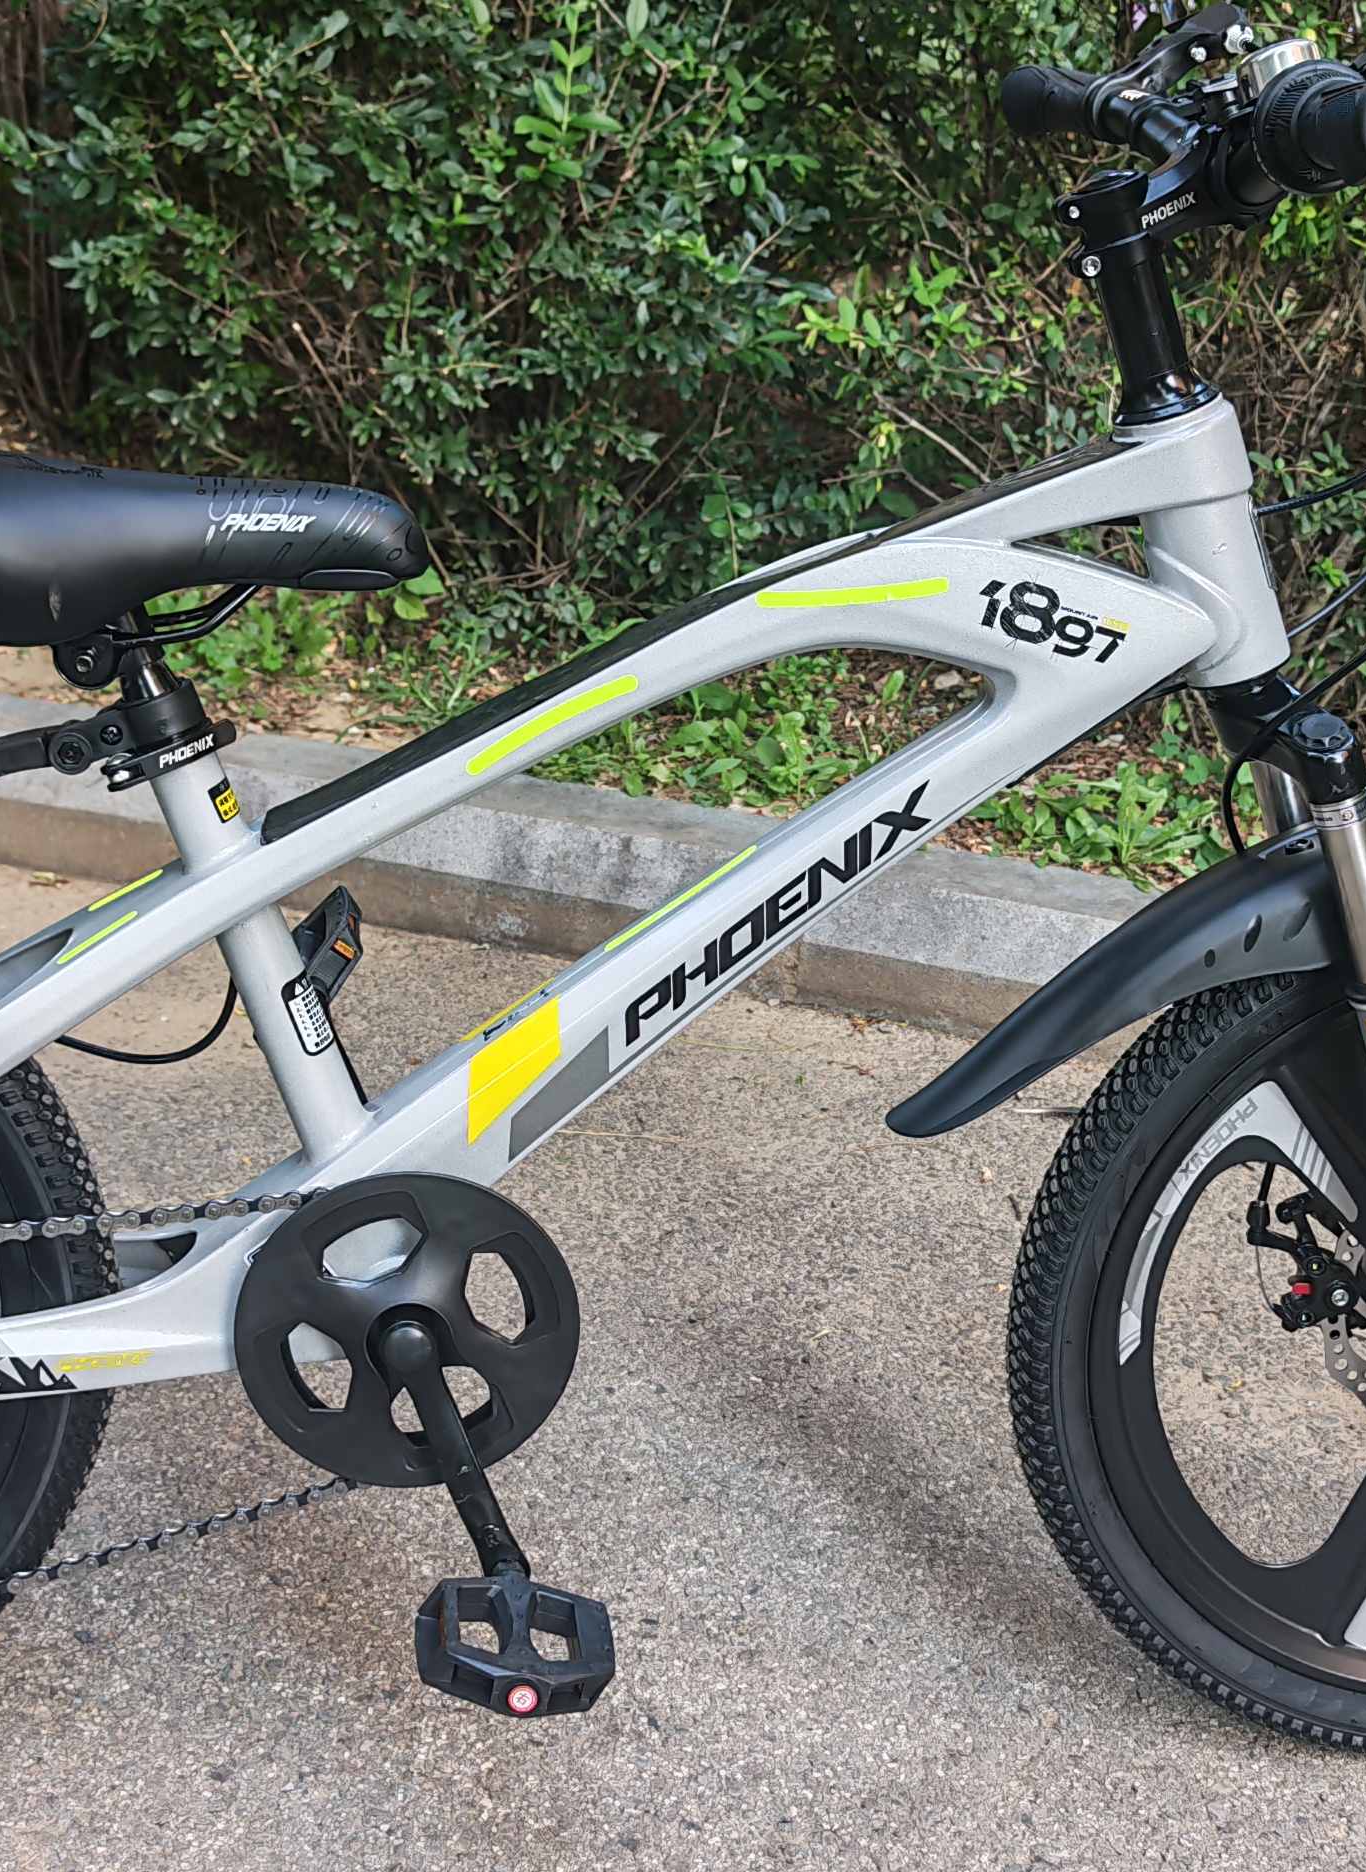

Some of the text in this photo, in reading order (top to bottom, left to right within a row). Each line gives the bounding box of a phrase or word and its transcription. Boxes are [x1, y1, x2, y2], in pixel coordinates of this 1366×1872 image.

[1141, 190, 1196, 229] PHOENIX
[220, 512, 317, 533] PHOENIX
[979, 579, 1126, 664] 1897
[159, 732, 214, 768] PHOENIX
[625, 779, 932, 1047] PHOENIX
[1178, 1097, 1258, 1179] PHOENIX
